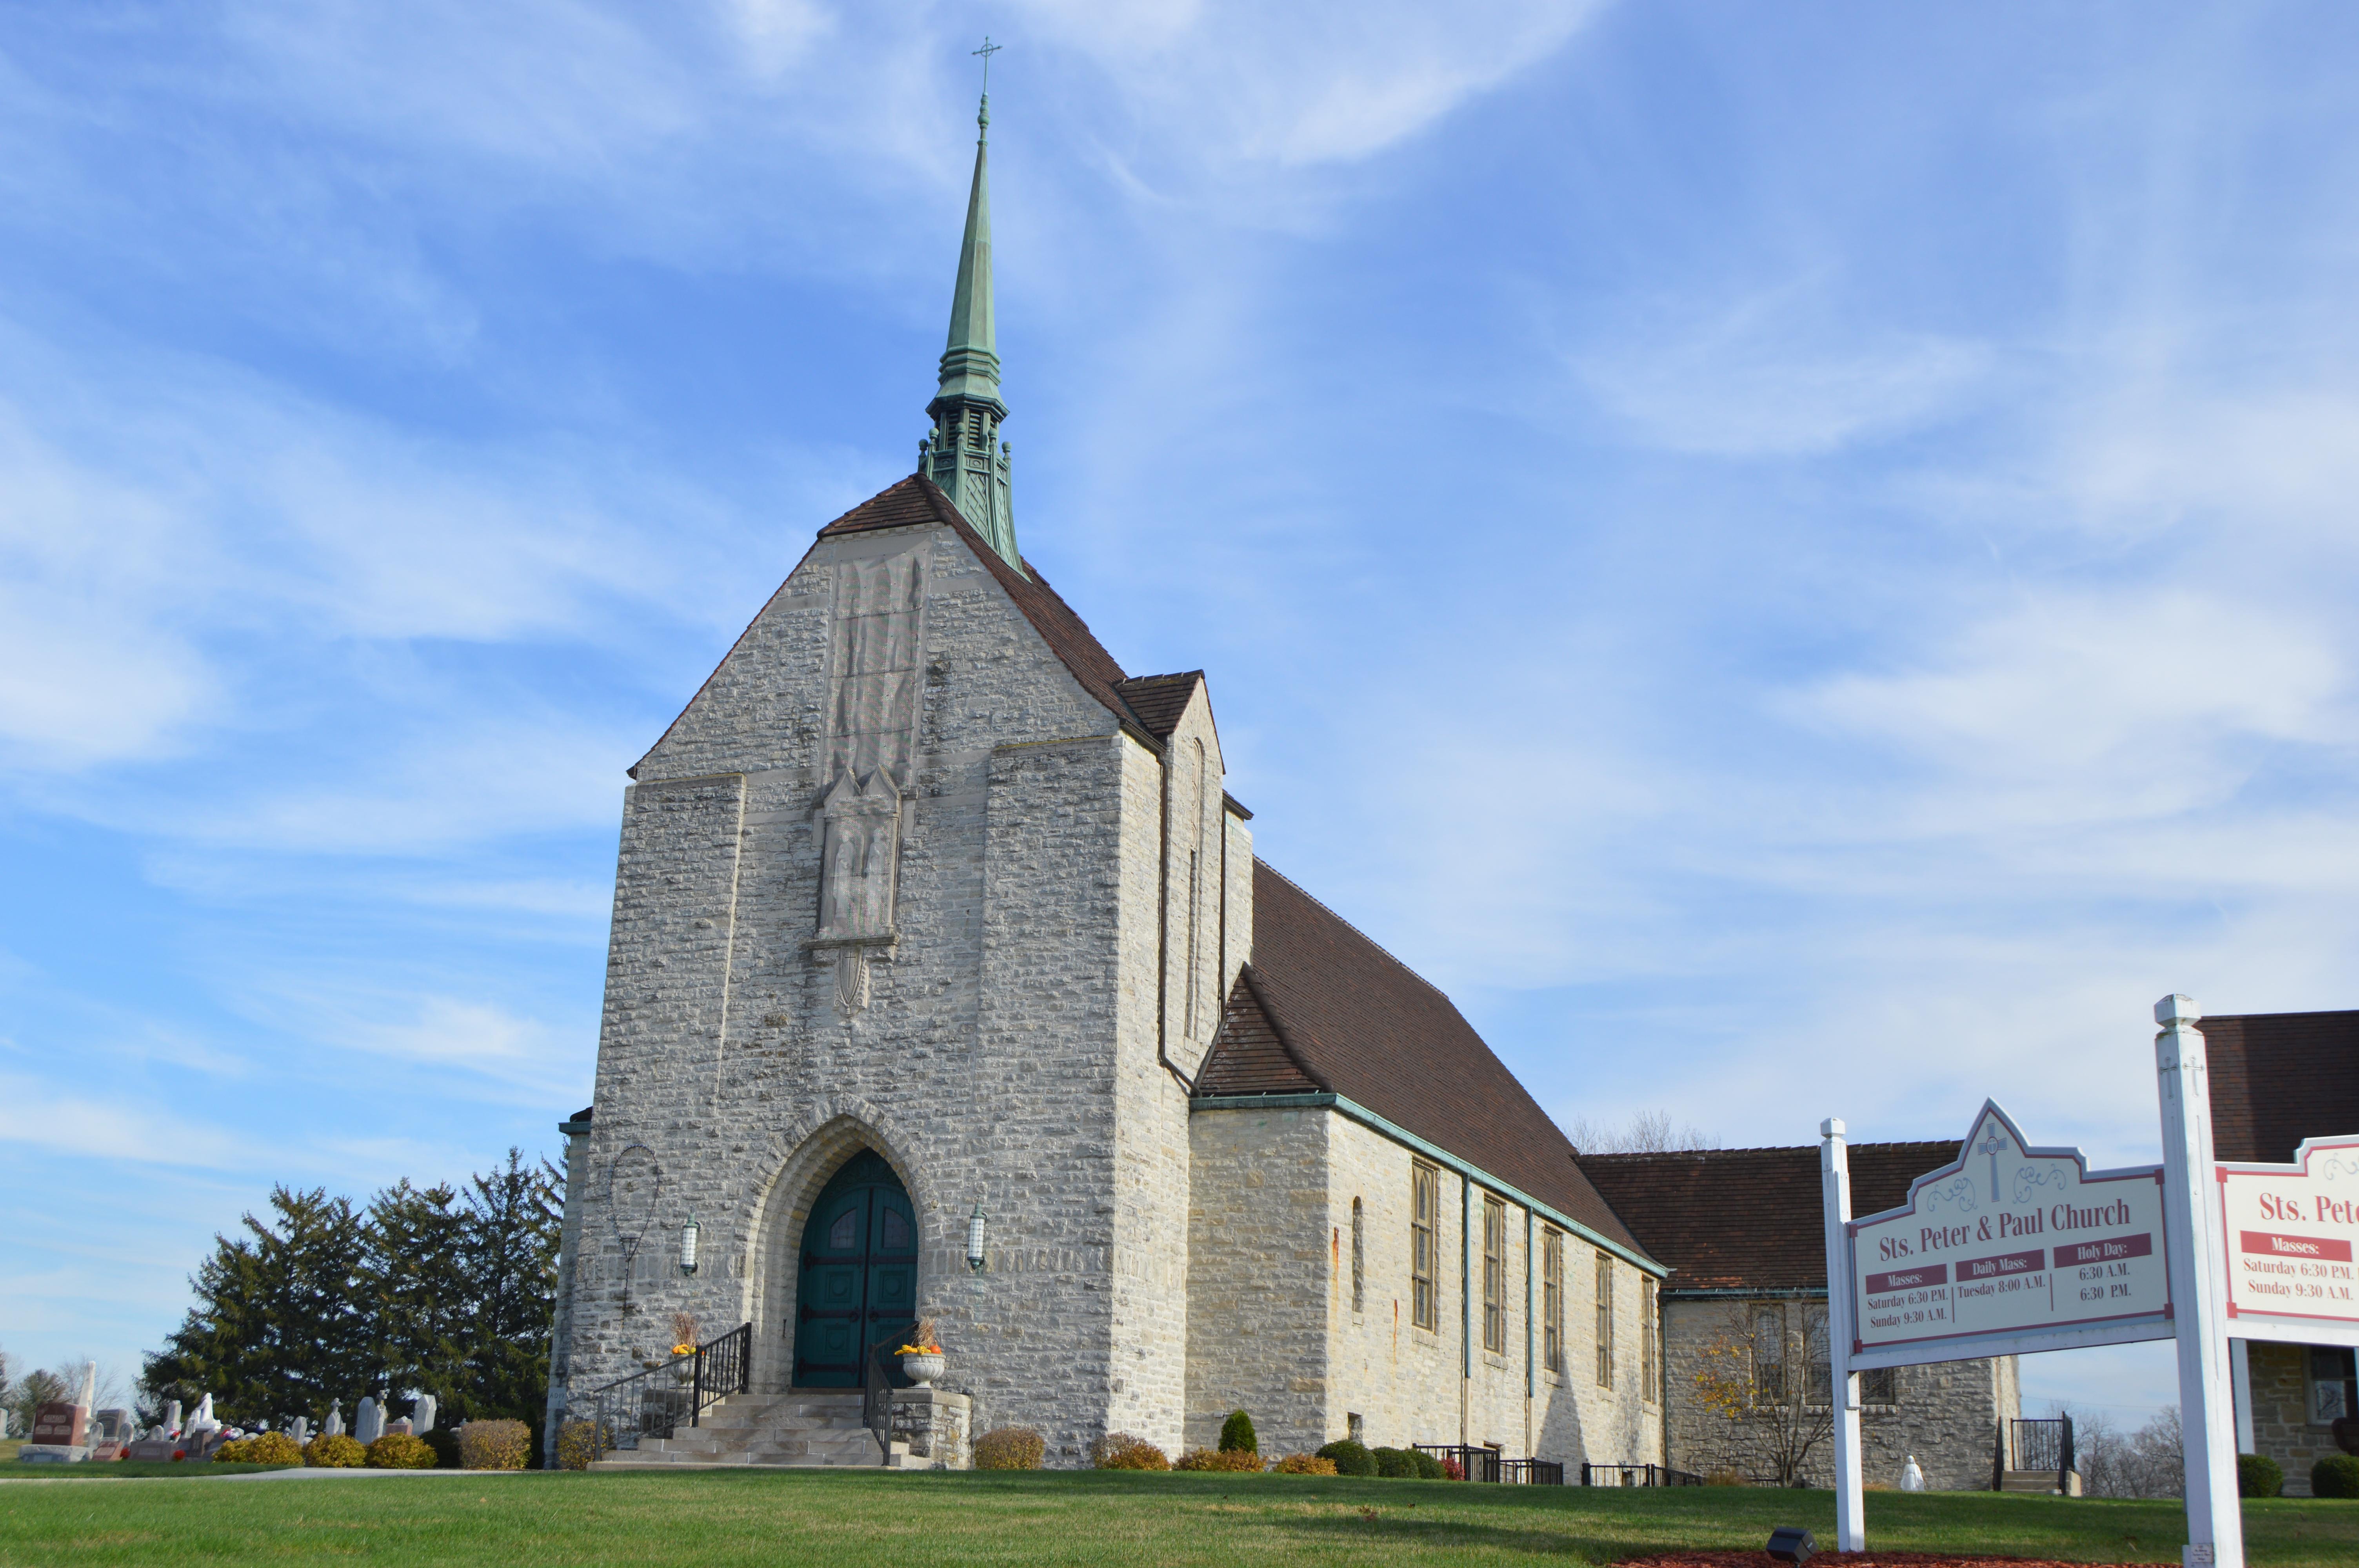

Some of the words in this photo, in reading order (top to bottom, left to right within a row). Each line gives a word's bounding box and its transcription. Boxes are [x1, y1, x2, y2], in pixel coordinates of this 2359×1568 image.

[2259, 1192, 2306, 1221] Sts.
[1880, 1237, 1914, 1261] Sts.
[1920, 1225, 1970, 1252] Peter
[1977, 1216, 1993, 1241] &
[1999, 1208, 2044, 1238] Paul
[2051, 1198, 2130, 1230] Church
[2077, 1245, 2101, 1260] Holy
[2104, 1243, 2127, 1257] Day:
[2272, 1237, 2319, 1254] Masses:
[1972, 1261, 1997, 1275] Daily
[1999, 1258, 2027, 1271] Mass:
[2079, 1266, 2103, 1280] 6:30
[2106, 1263, 2130, 1277] A.M.
[2244, 1258, 2296, 1278] Saturday
[2301, 1263, 2327, 1277] 6:30
[2331, 1265, 2354, 1279] P.M.
[1888, 1274, 1922, 1287] Masses:
[1957, 1283, 1996, 1298] Tuesday
[1999, 1278, 2020, 1293] 8:00
[2023, 1275, 2045, 1290] A.M.
[2248, 1279, 2292, 1298] Sunday
[2295, 1283, 2322, 1298] 9:30
[2327, 1286, 2353, 1300] A.M.
[1868, 1296, 1906, 1310] Saturday
[1908, 1291, 1928, 1305] 6:30
[1931, 1289, 1948, 1301] P.M.
[2080, 1286, 2104, 1301] 6:30
[2111, 1283, 2131, 1298] P.M.
[1871, 1314, 1901, 1328] Sunday
[1904, 1310, 1924, 1324] 9:30
[1927, 1308, 1946, 1321] A.M.
